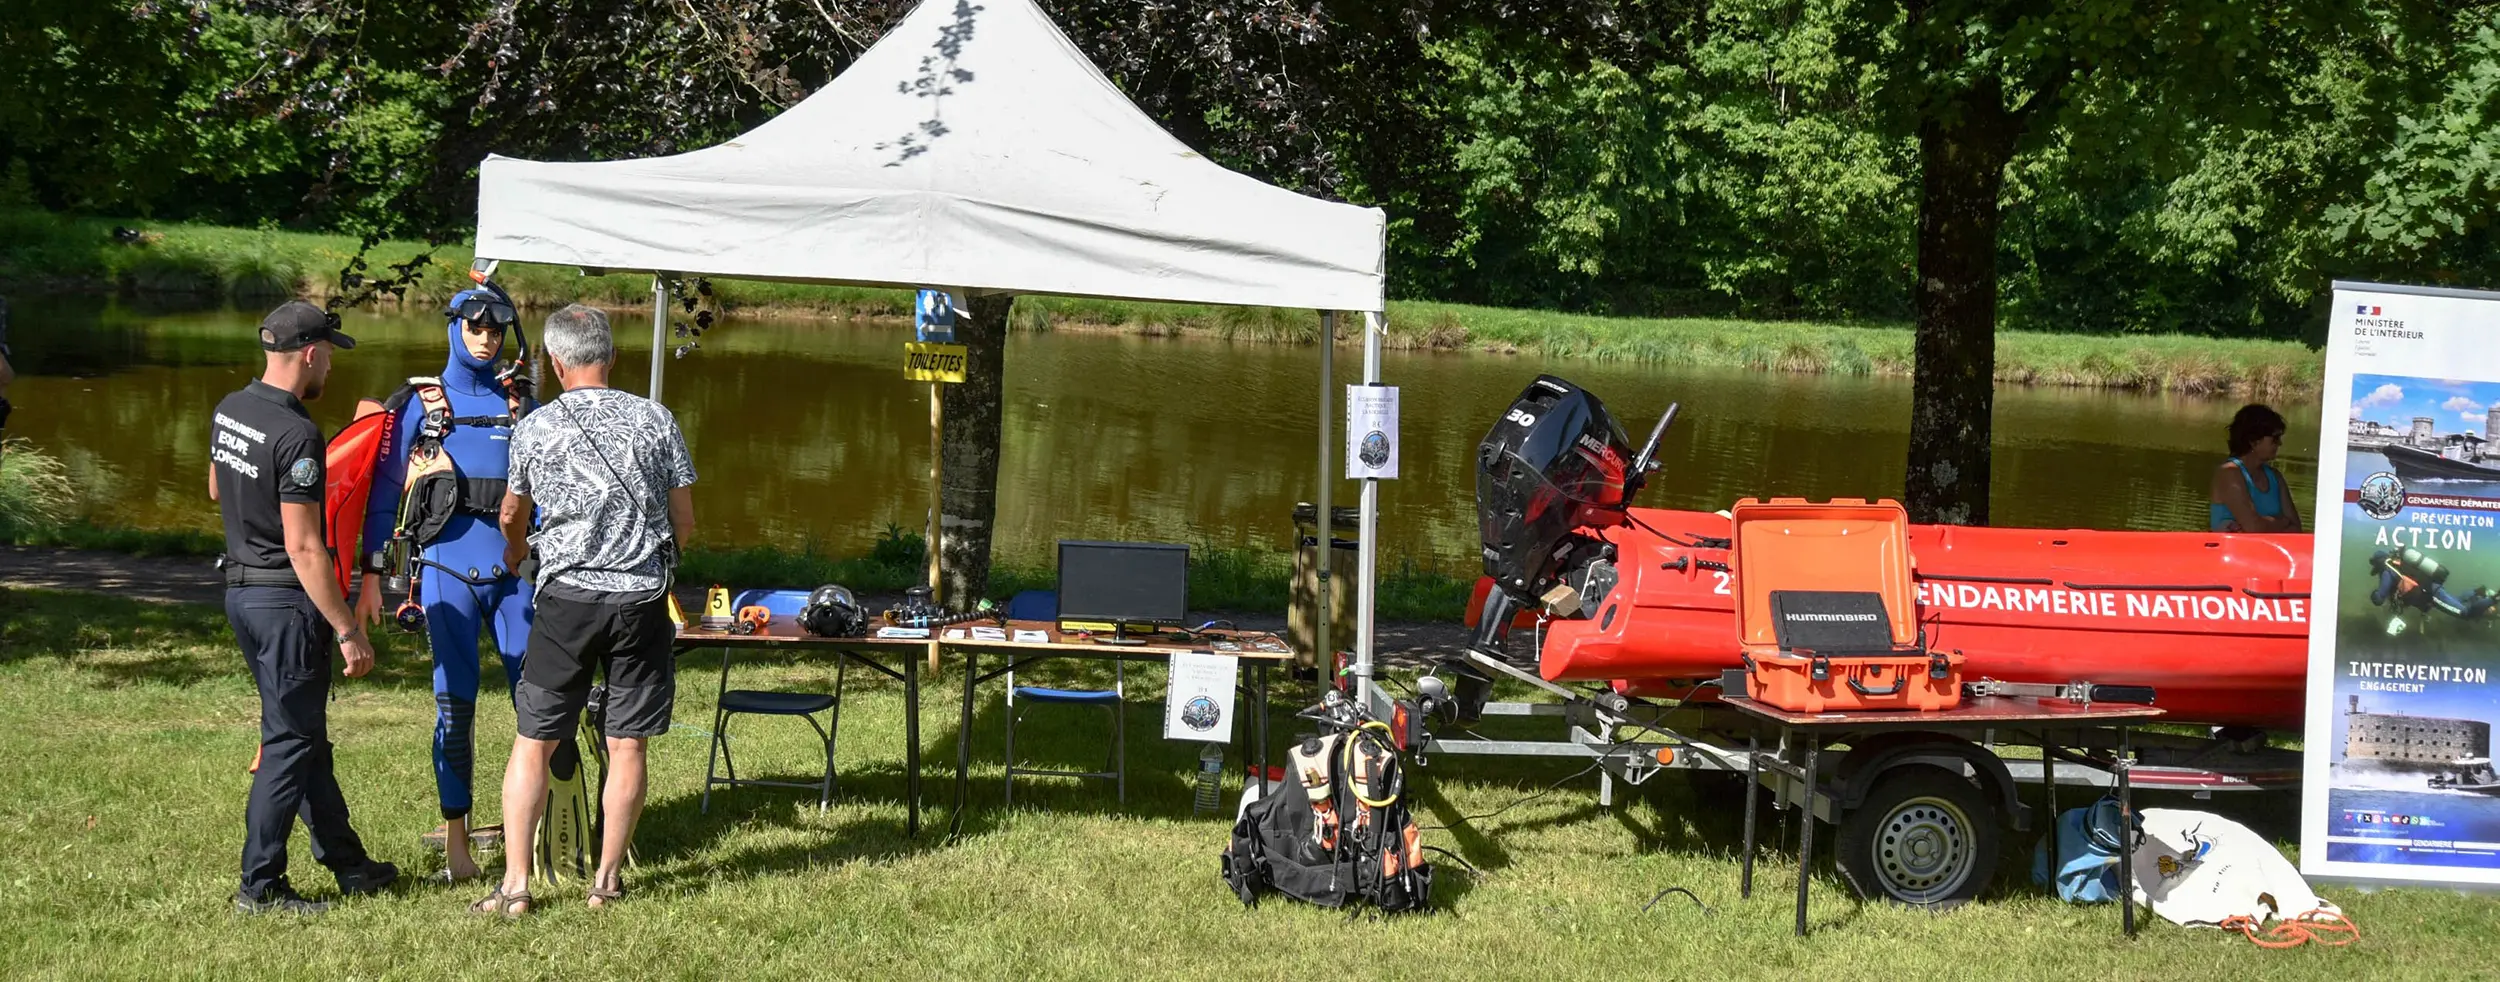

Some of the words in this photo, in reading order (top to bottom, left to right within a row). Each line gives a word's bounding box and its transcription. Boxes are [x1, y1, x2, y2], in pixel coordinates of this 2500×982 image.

[2355, 317, 2404, 329] MINISTÈRE
[2354, 327, 2367, 336] DE
[2369, 328, 2424, 340] L'INTÉRIEUR
[908, 352, 963, 372] TOILETTES
[1506, 408, 1535, 427] 30
[2407, 496, 2459, 507] GENDARMERIE
[2460, 496, 2500, 509] DÉPARTE
[2411, 512, 2494, 528] PRÉVENTION
[2375, 525, 2472, 551] ACTION
[713, 592, 723, 609] 5
[1713, 571, 1731, 595] 2
[1918, 582, 2117, 616] ENDARMERIE
[2125, 592, 2307, 623] NATIONALE
[1785, 613, 1877, 622] HUMMINBIRD
[2348, 661, 2486, 683] INTERVENTION
[2359, 681, 2425, 693] ENGAGEMENT
